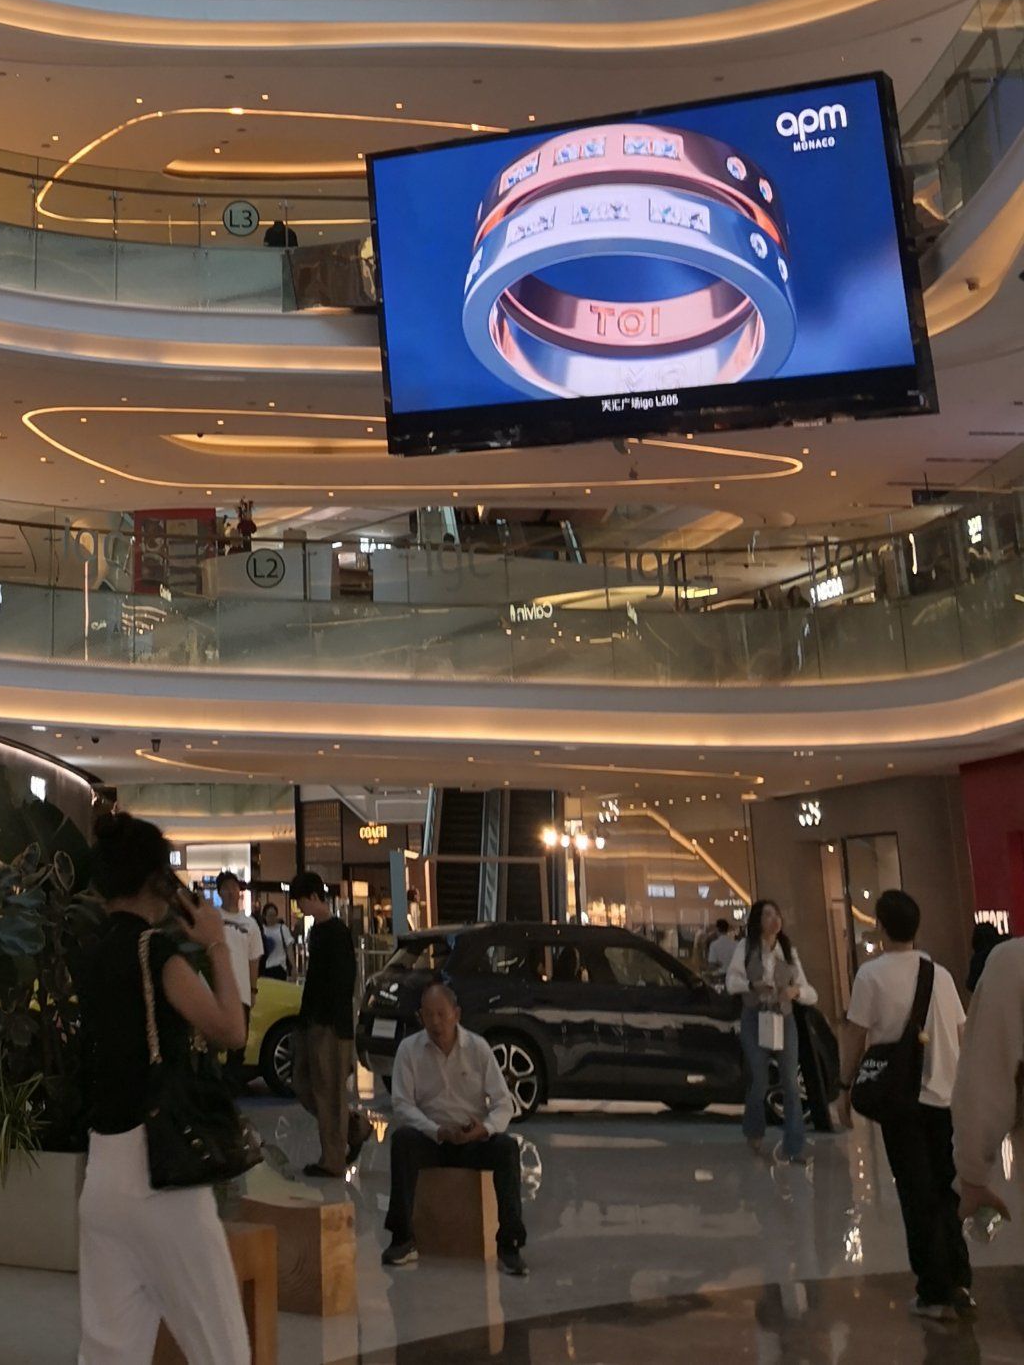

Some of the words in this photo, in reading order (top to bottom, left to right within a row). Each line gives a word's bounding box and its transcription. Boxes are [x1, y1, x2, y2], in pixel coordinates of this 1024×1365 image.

[775, 103, 848, 142] apm
[792, 136, 836, 153] MONACO
[228, 209, 254, 229] L3
[589, 303, 661, 338] TOI
[253, 557, 278, 578] L2
[359, 825, 388, 839] COACH
